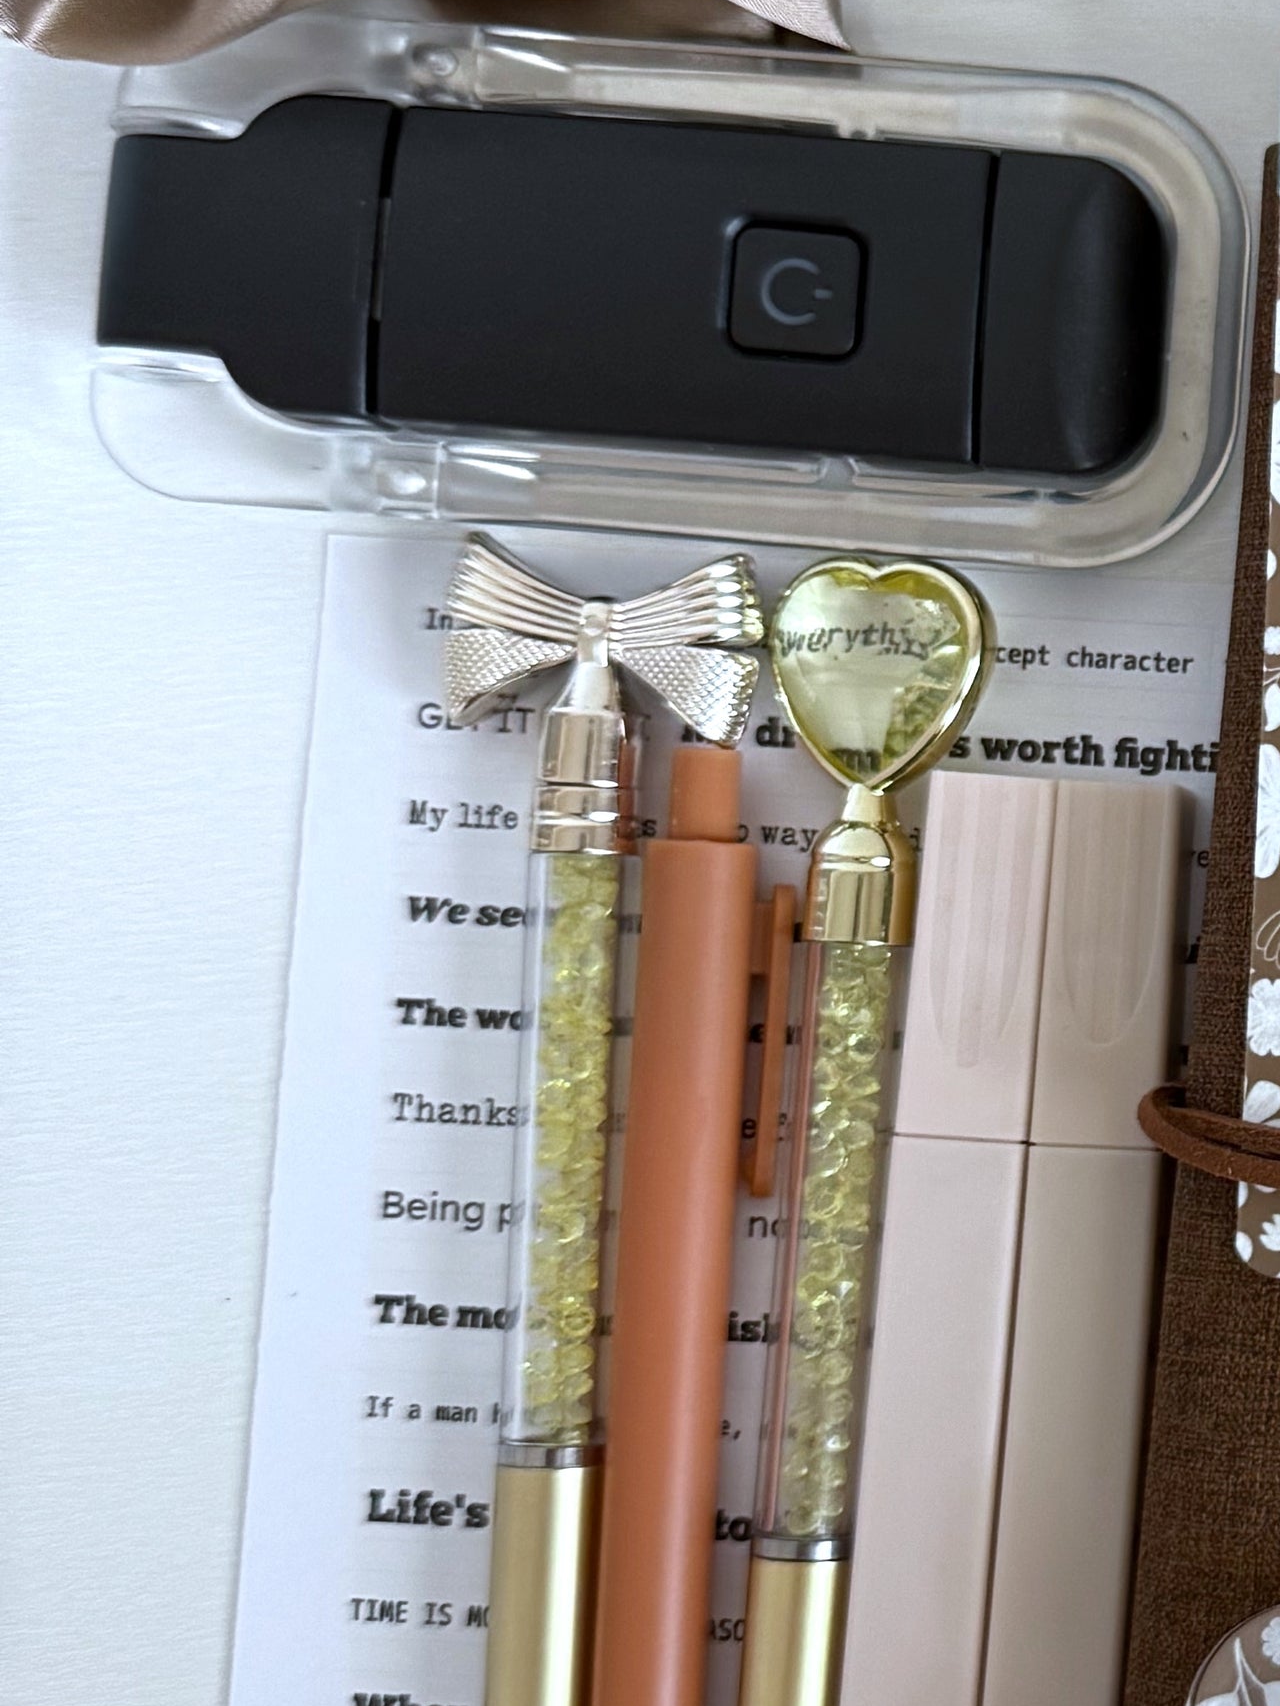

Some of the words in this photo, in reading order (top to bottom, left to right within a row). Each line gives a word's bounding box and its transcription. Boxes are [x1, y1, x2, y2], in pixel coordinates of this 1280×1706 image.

[992, 645, 1050, 671] cept
[1066, 645, 1196, 675] character
[981, 736, 1106, 767] worth
[408, 799, 449, 832] My
[457, 802, 519, 830] life
[407, 895, 469, 927] We
[396, 997, 468, 1029] The
[382, 1191, 486, 1232] Being
[373, 1295, 449, 1329] The
[367, 1395, 394, 1419] If
[408, 1403, 422, 1421] a
[435, 1404, 478, 1424] man
[367, 1489, 490, 1529] Life's
[350, 1597, 409, 1624] TIME
[424, 1602, 454, 1627] IS
